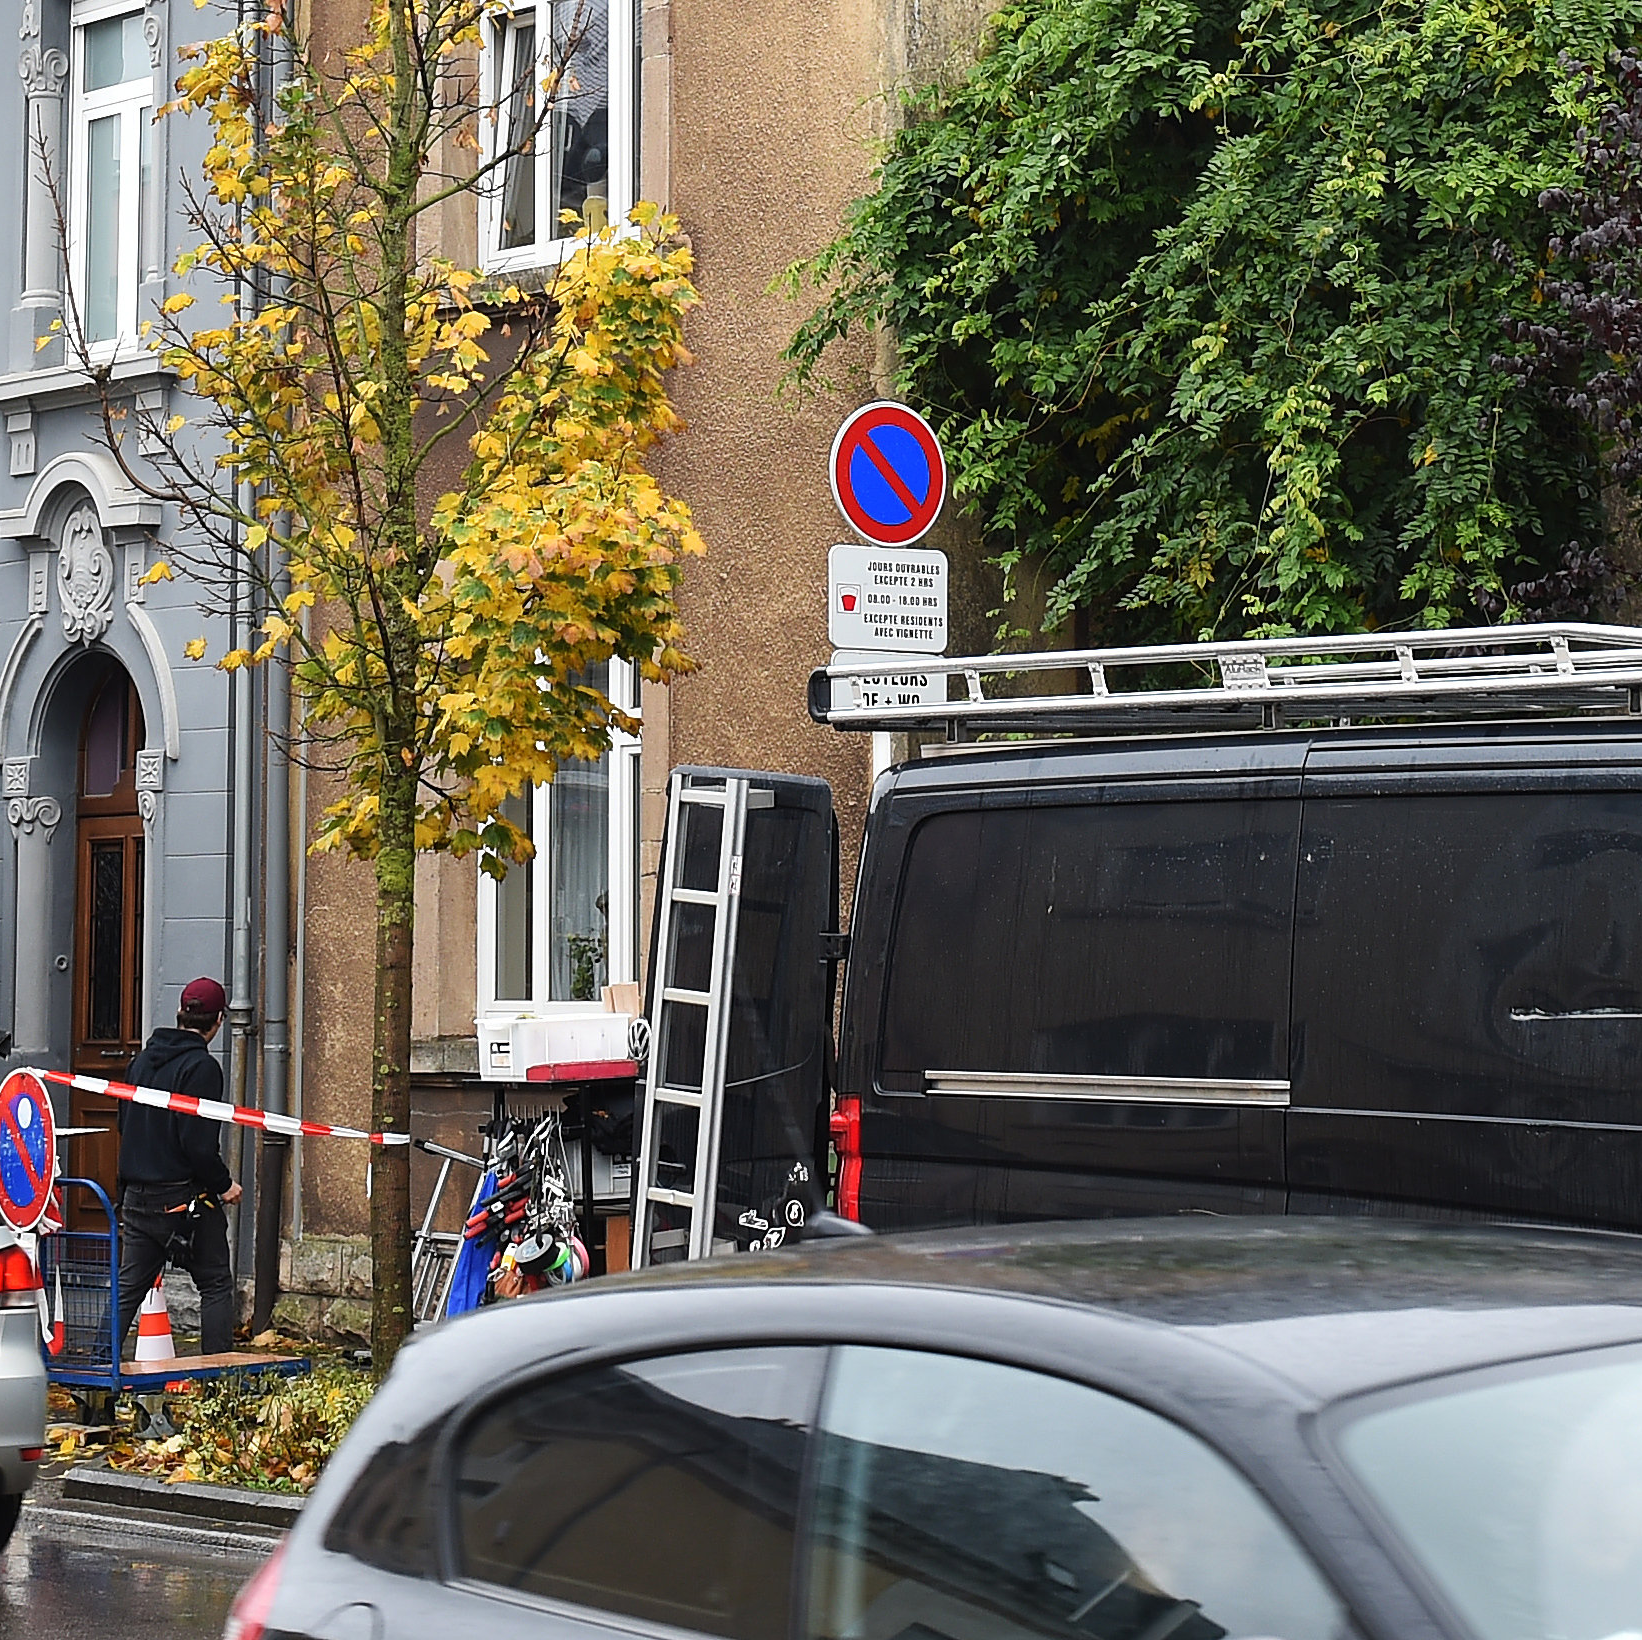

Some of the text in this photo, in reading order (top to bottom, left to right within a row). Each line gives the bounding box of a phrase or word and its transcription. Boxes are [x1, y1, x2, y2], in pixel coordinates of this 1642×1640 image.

[868, 561, 940, 575] JOURS OUVRABLES
[874, 575, 934, 587] EXCEPTE 2 HRS
[867, 594, 890, 604] 08.00
[899, 596, 920, 606] 18.00
[923, 597, 938, 607] HRS
[864, 613, 943, 627] EXCEPTE RESIDENTS
[874, 627, 934, 639] AVEC VIGNETTE
